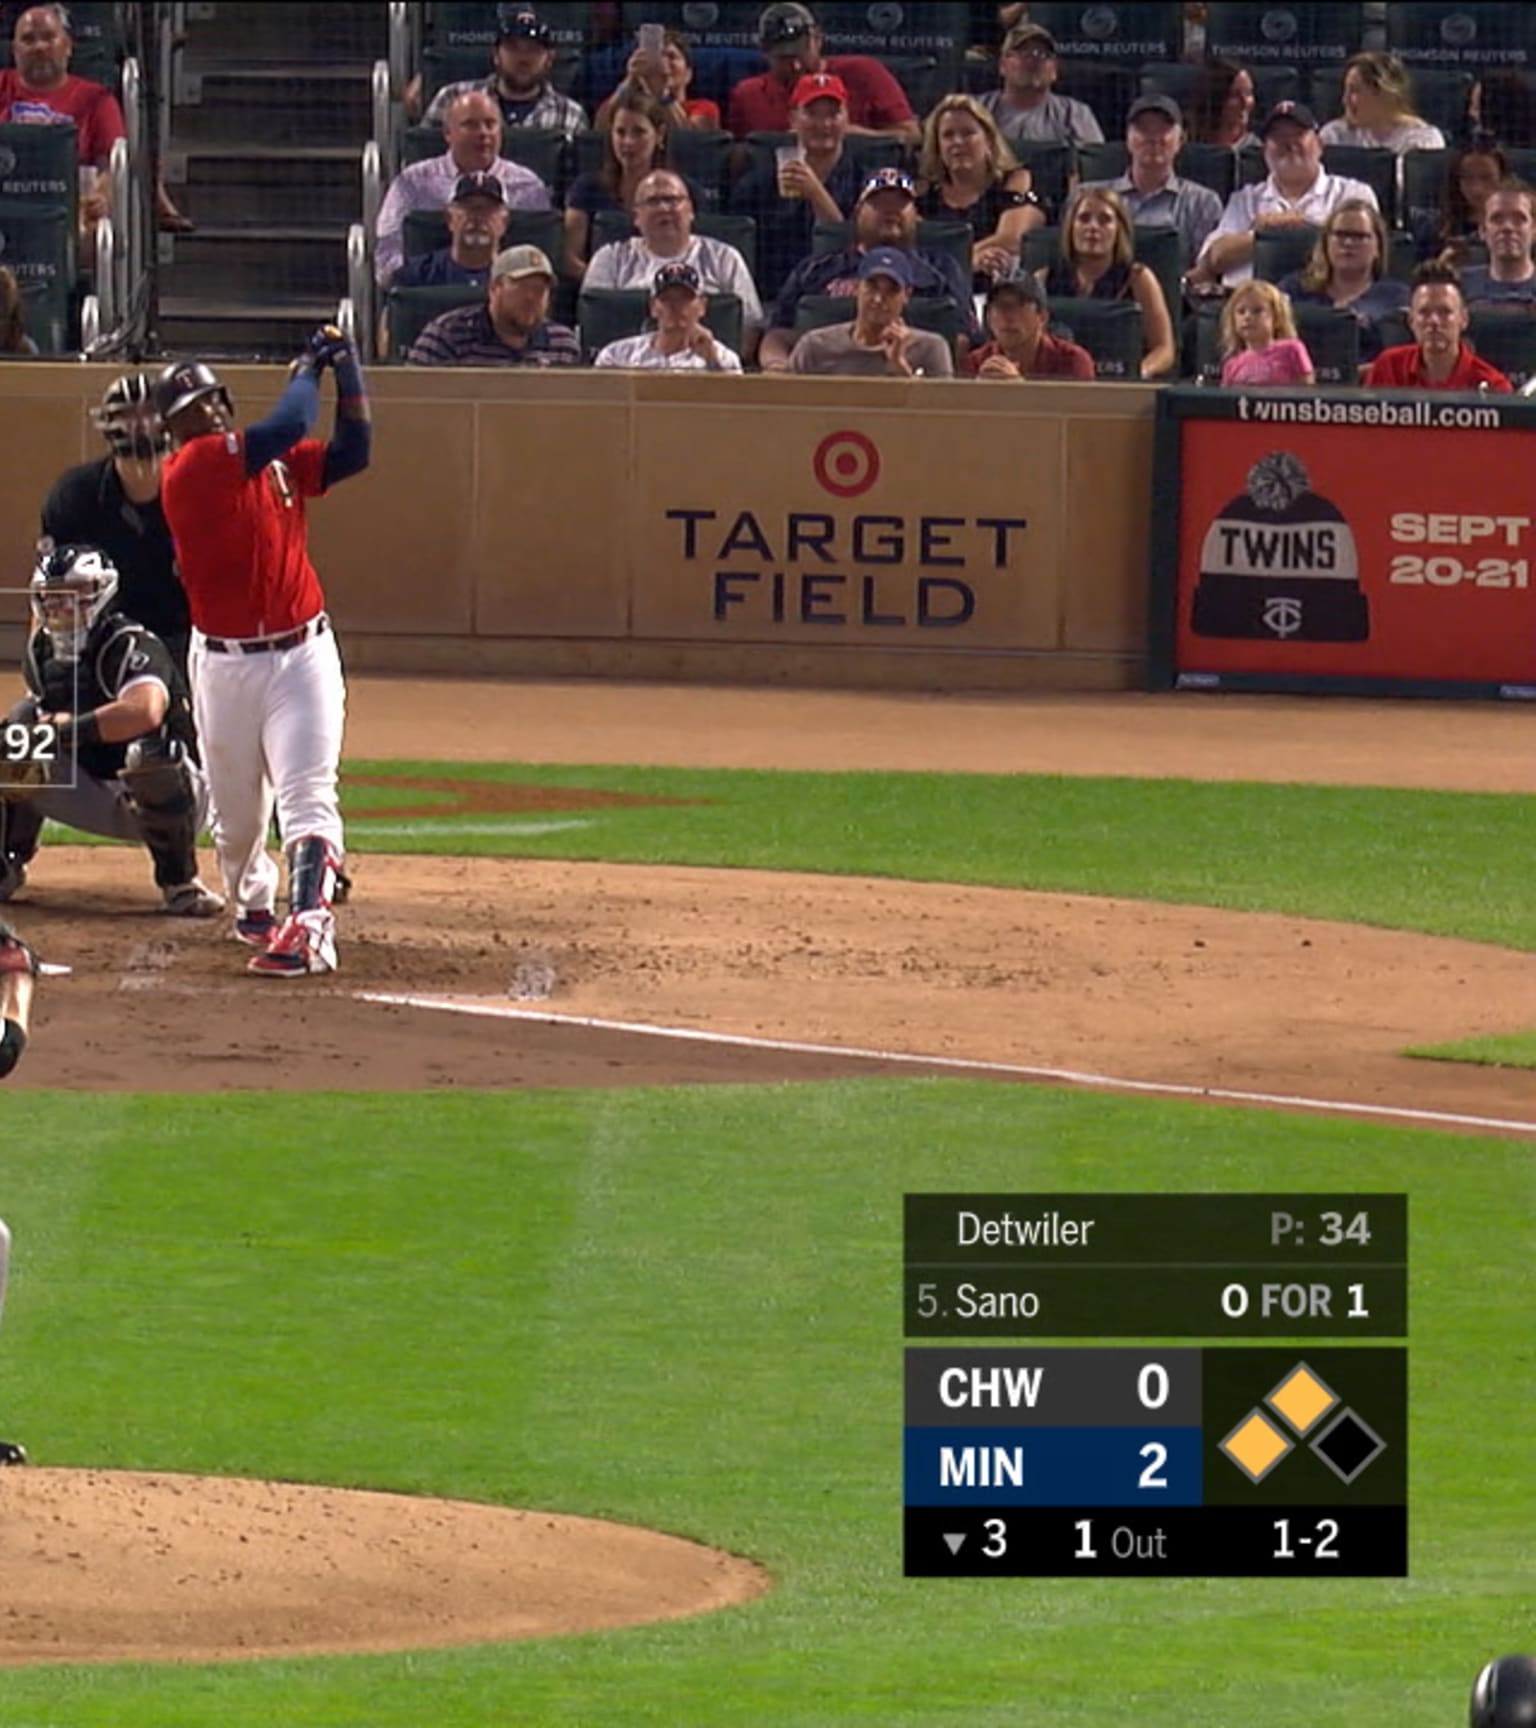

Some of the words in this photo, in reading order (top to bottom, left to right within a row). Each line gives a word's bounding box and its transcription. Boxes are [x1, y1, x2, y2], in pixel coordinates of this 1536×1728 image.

[448, 31, 497, 44] THOMS
[824, 33, 886, 46] HOMSON
[1103, 41, 1167, 55] REUTERS
[2, 181, 68, 194] REUTERS
[1238, 396, 1501, 428] twinsbaseball.com
[666, 509, 1027, 569] TARGET
[1389, 512, 1530, 547] SEPT
[1220, 526, 1336, 571] TWINS
[1389, 554, 1529, 589] 20-21
[713, 571, 976, 628] FIELD
